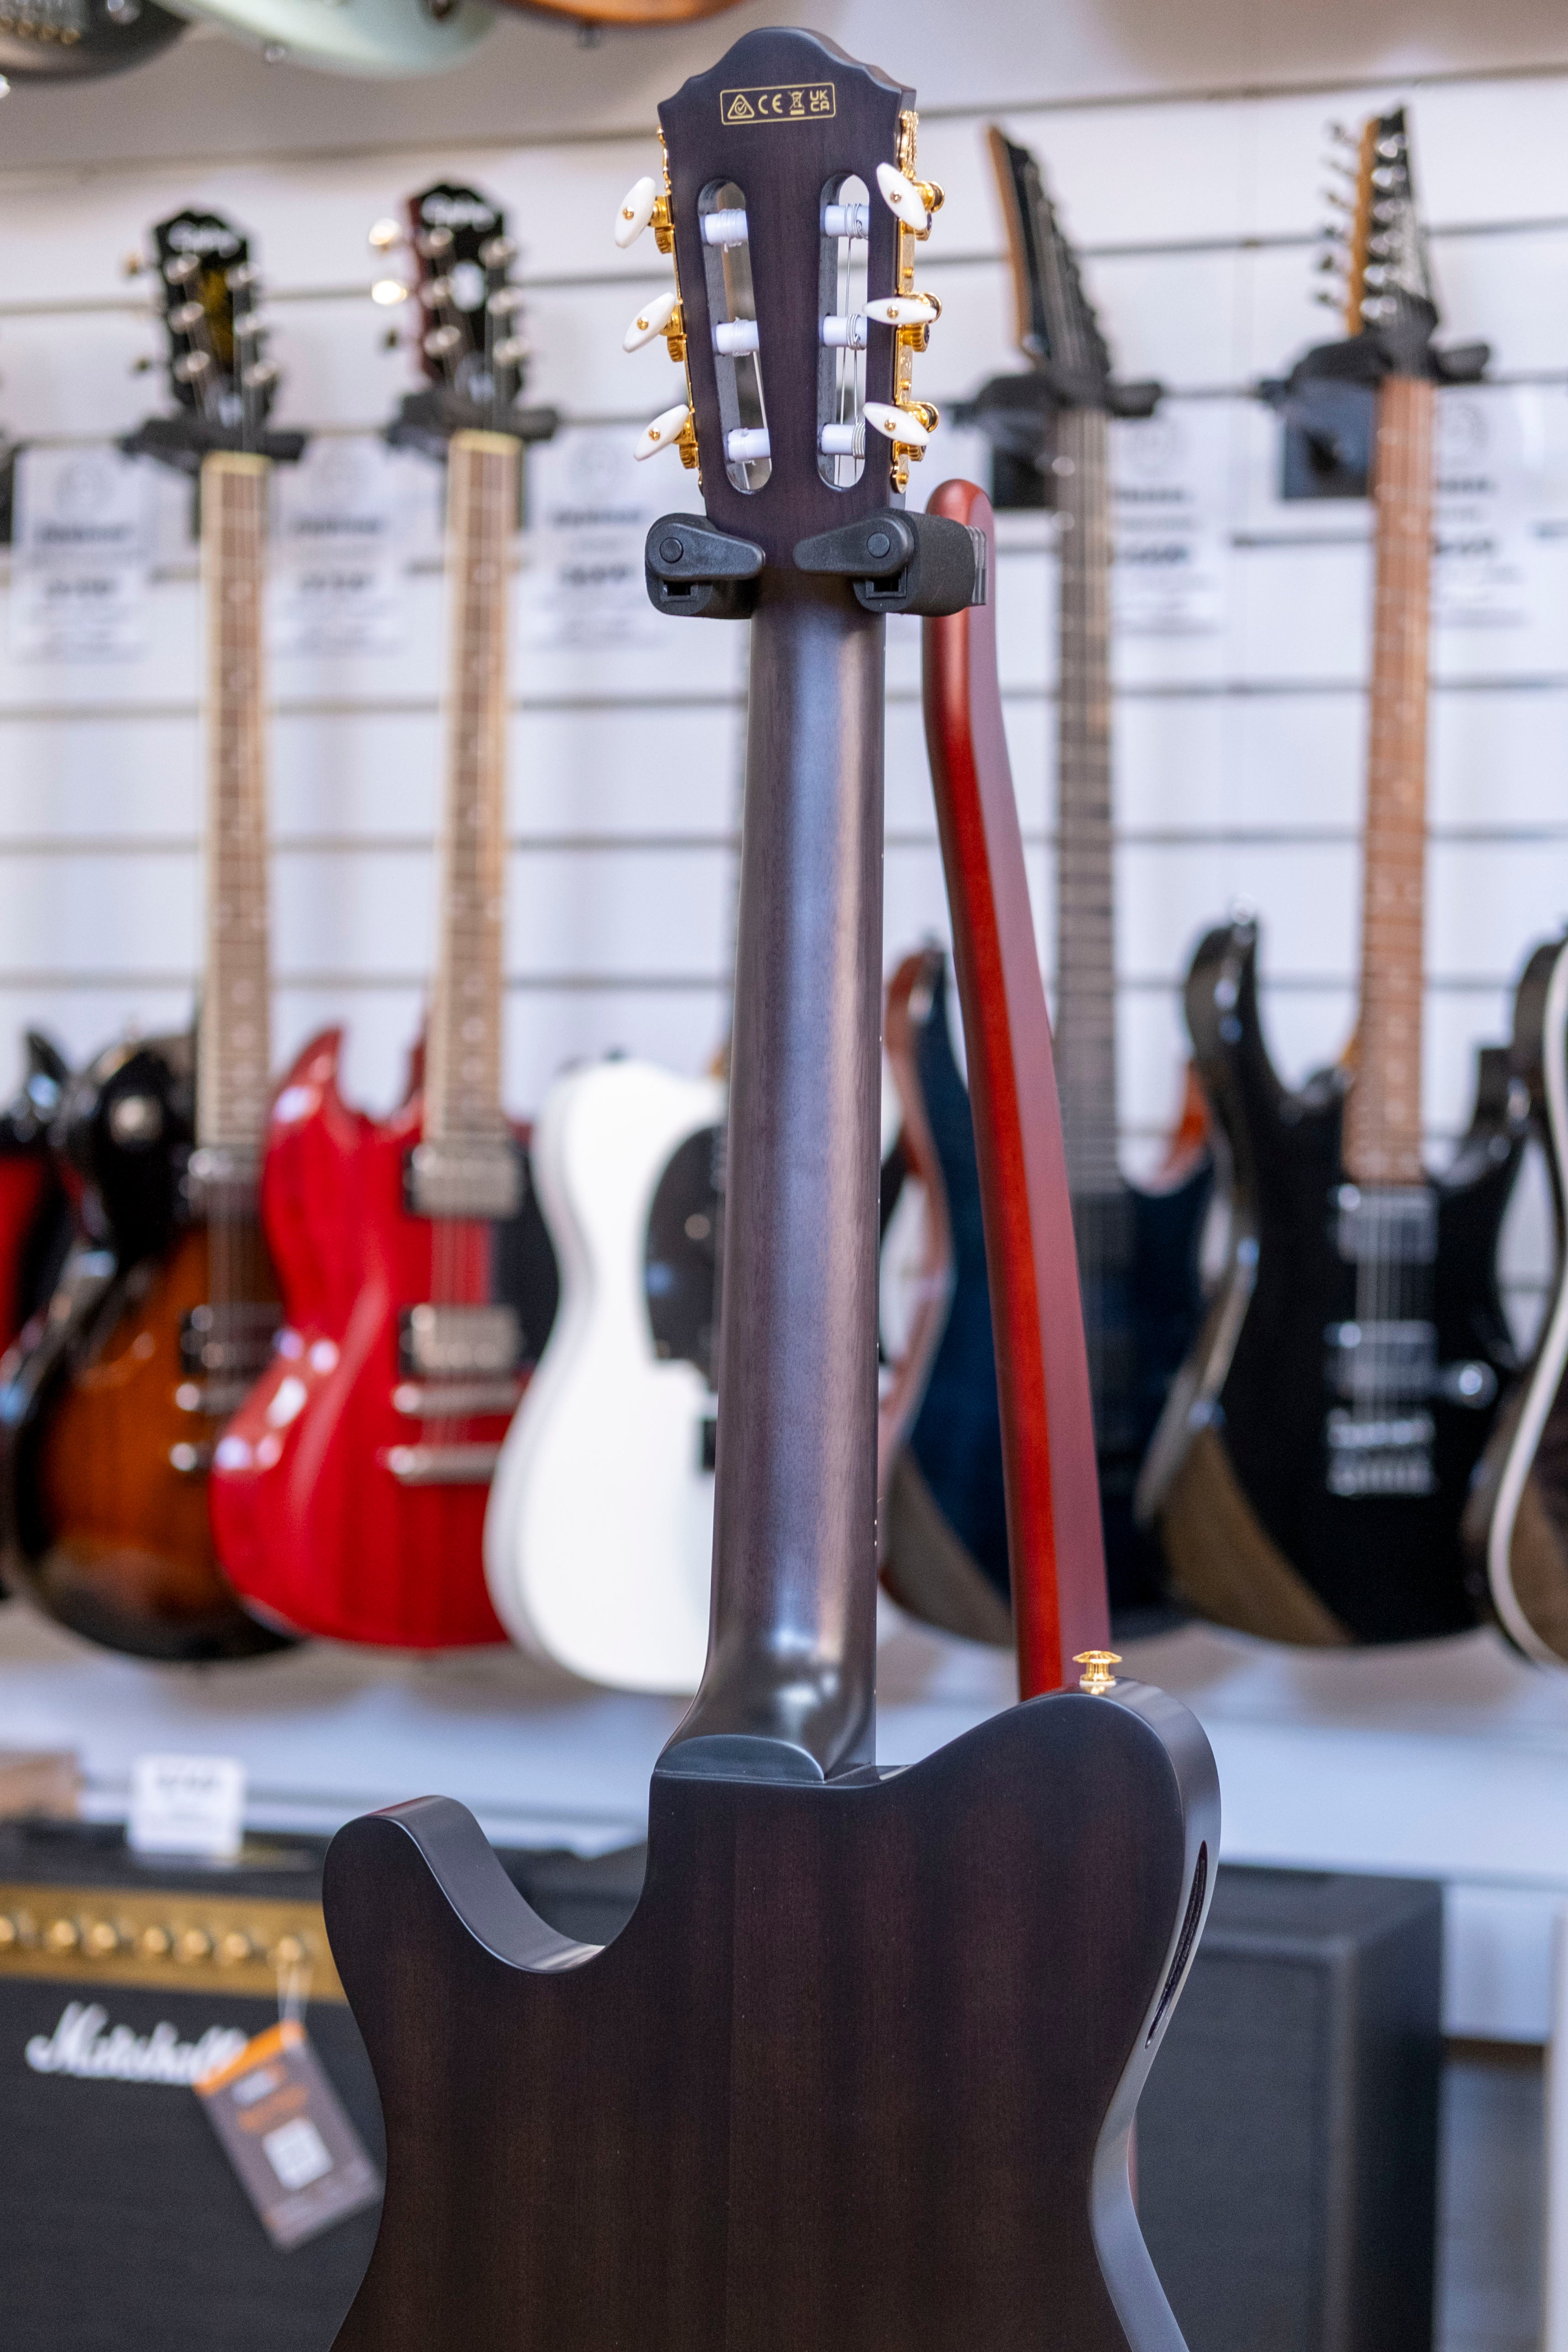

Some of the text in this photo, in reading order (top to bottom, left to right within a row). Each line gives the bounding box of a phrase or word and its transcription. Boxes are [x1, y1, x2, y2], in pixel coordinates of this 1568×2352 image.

[810, 90, 828, 101] UK
[758, 93, 783, 114] CE
[810, 100, 830, 112] CA
